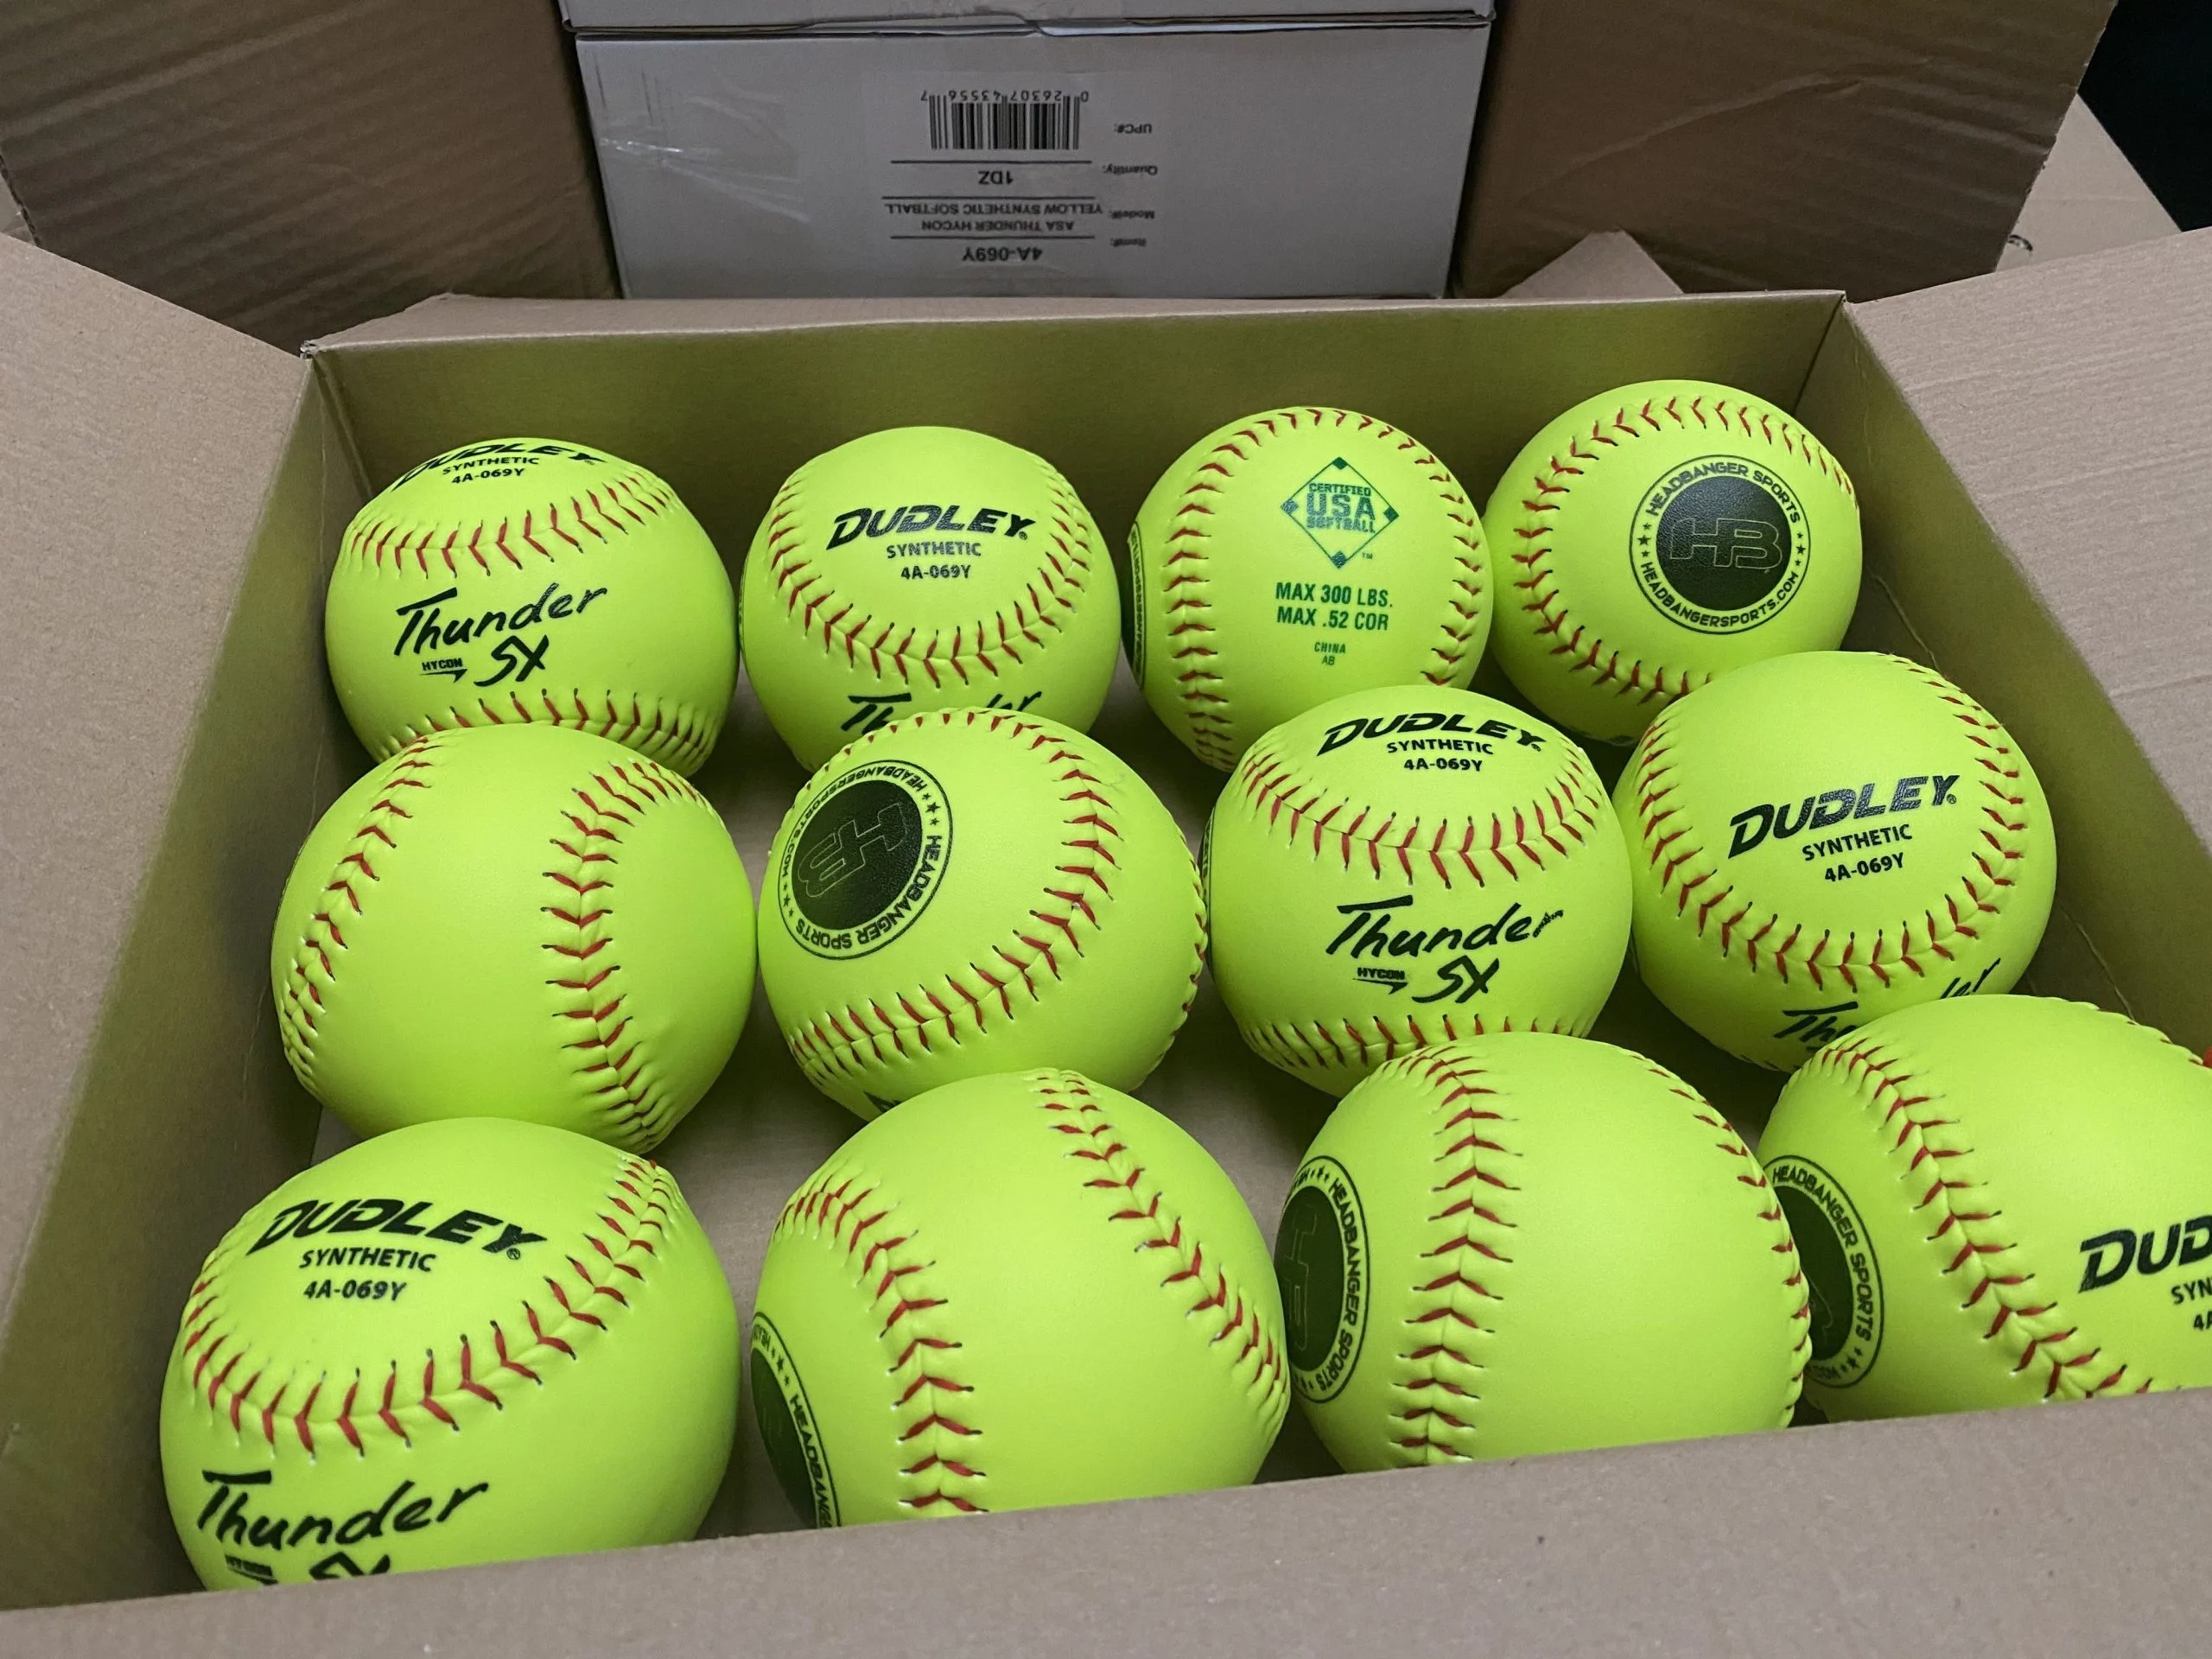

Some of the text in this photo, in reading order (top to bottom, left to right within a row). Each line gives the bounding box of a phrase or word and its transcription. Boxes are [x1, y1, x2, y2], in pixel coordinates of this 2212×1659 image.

[920, 91, 928, 102] 7
[949, 90, 1001, 102] 43556
[1010, 90, 1062, 102] 26307
[978, 170, 1013, 185] 1DZ
[1103, 163, 1159, 176] Quantity:
[885, 203, 1103, 215] YELLOW SYNTHETIC SOFTBALL
[922, 220, 1075, 232] ASA THUNDER HYCON
[962, 246, 1043, 262] 4A-069Y
[442, 457, 540, 475] SYNTHETIC
[451, 468, 525, 484] 4A-069Y
[1309, 482, 1372, 496] CERTIFIED
[1645, 461, 1801, 524] HEADBANGER SPORTS
[1306, 492, 1376, 520] USA
[826, 505, 1036, 550] DUDLEY
[1306, 516, 1376, 534] SOFTBALL
[886, 541, 982, 559] SYNTHETIC
[1669, 518, 1783, 570] HB
[901, 564, 971, 580] 4A-069Y
[1275, 582, 1393, 608] MAX 300 LBS.
[1641, 562, 1799, 627] HEADBANGERSPORTS.COM
[394, 582, 608, 657] Thunder
[1276, 606, 1389, 631] MAX .52 COR
[1313, 642, 1346, 654] CHINA
[1321, 655, 1336, 666] AB
[422, 658, 463, 671] HYCON
[473, 635, 550, 688] SX
[1316, 712, 1547, 756] DUDLEY
[1387, 738, 1494, 755] SYNTHETIC
[1403, 757, 1483, 772] 4A-069Y
[782, 766, 927, 878] HEADBANGERSPORTS.COM
[1728, 774, 1960, 860] DUDLEY
[1802, 823, 1913, 861] SYNTHETIC
[1824, 852, 1904, 882] 4A-069Y
[796, 835, 943, 950] HEADBANGER SPORTS
[1325, 894, 1564, 959] Thunder
[1411, 955, 1500, 1004] SX
[245, 1198, 548, 1255] DUDLEY
[299, 1247, 436, 1273] SYNTHETIC
[1772, 1166, 1873, 1341] HEADBANGER SPORTS
[303, 1279, 407, 1301] 4A-069Y
[1316, 1176, 1362, 1391] HEADBANGER SPORTS
[2171, 1277, 2212, 1305] SYN
[197, 1469, 489, 1551] Thunder
